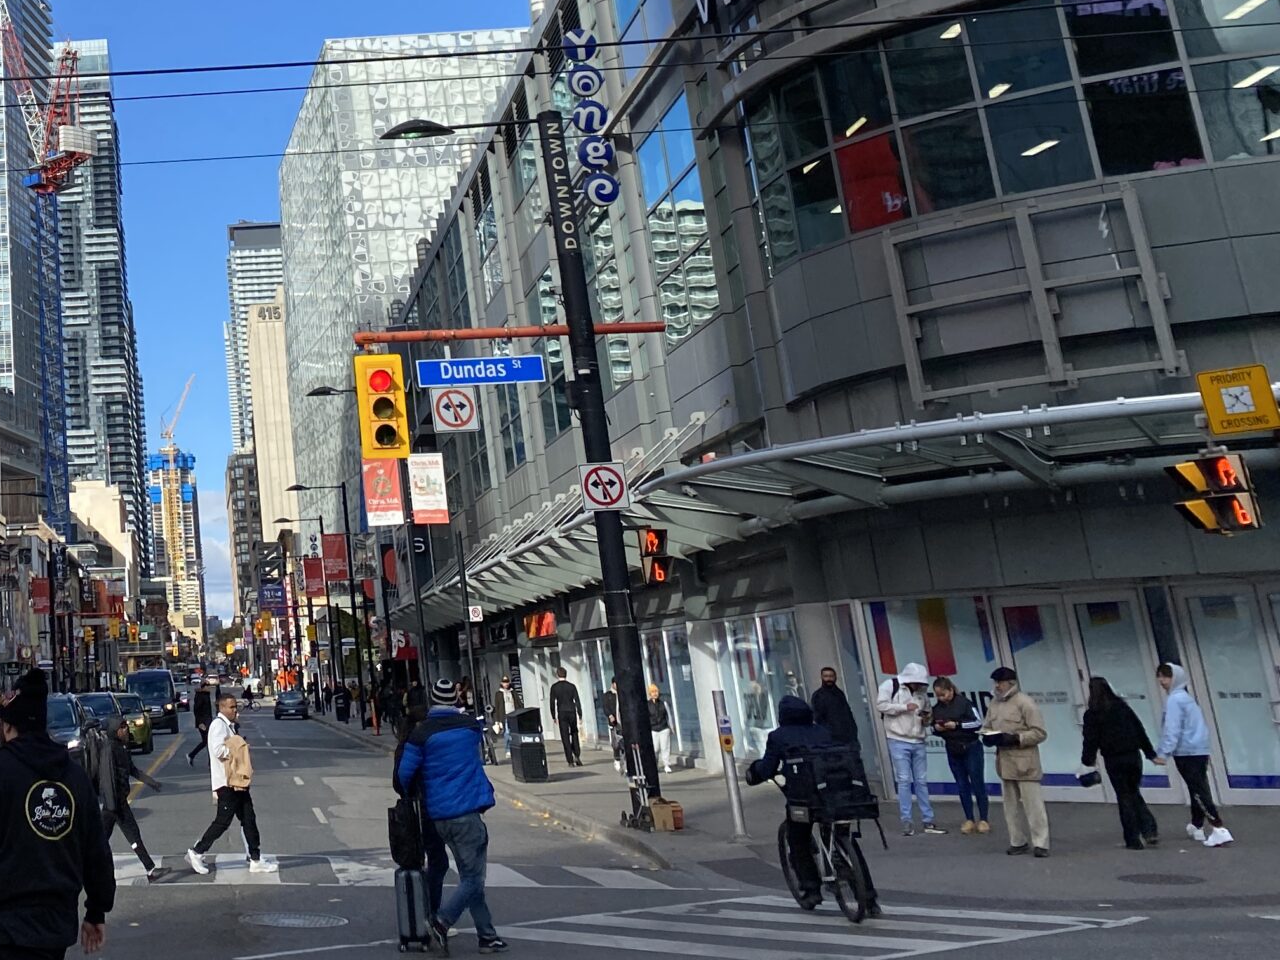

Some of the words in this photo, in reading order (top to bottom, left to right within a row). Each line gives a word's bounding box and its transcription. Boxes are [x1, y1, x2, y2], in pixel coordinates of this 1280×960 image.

[546, 122, 578, 250] DOWNTOWN
[257, 305, 282, 321] 415
[440, 361, 507, 379] Dundas
[512, 359, 522, 369] St
[1209, 370, 1253, 386] PRIORITY
[1220, 413, 1270, 431] CROSSING
